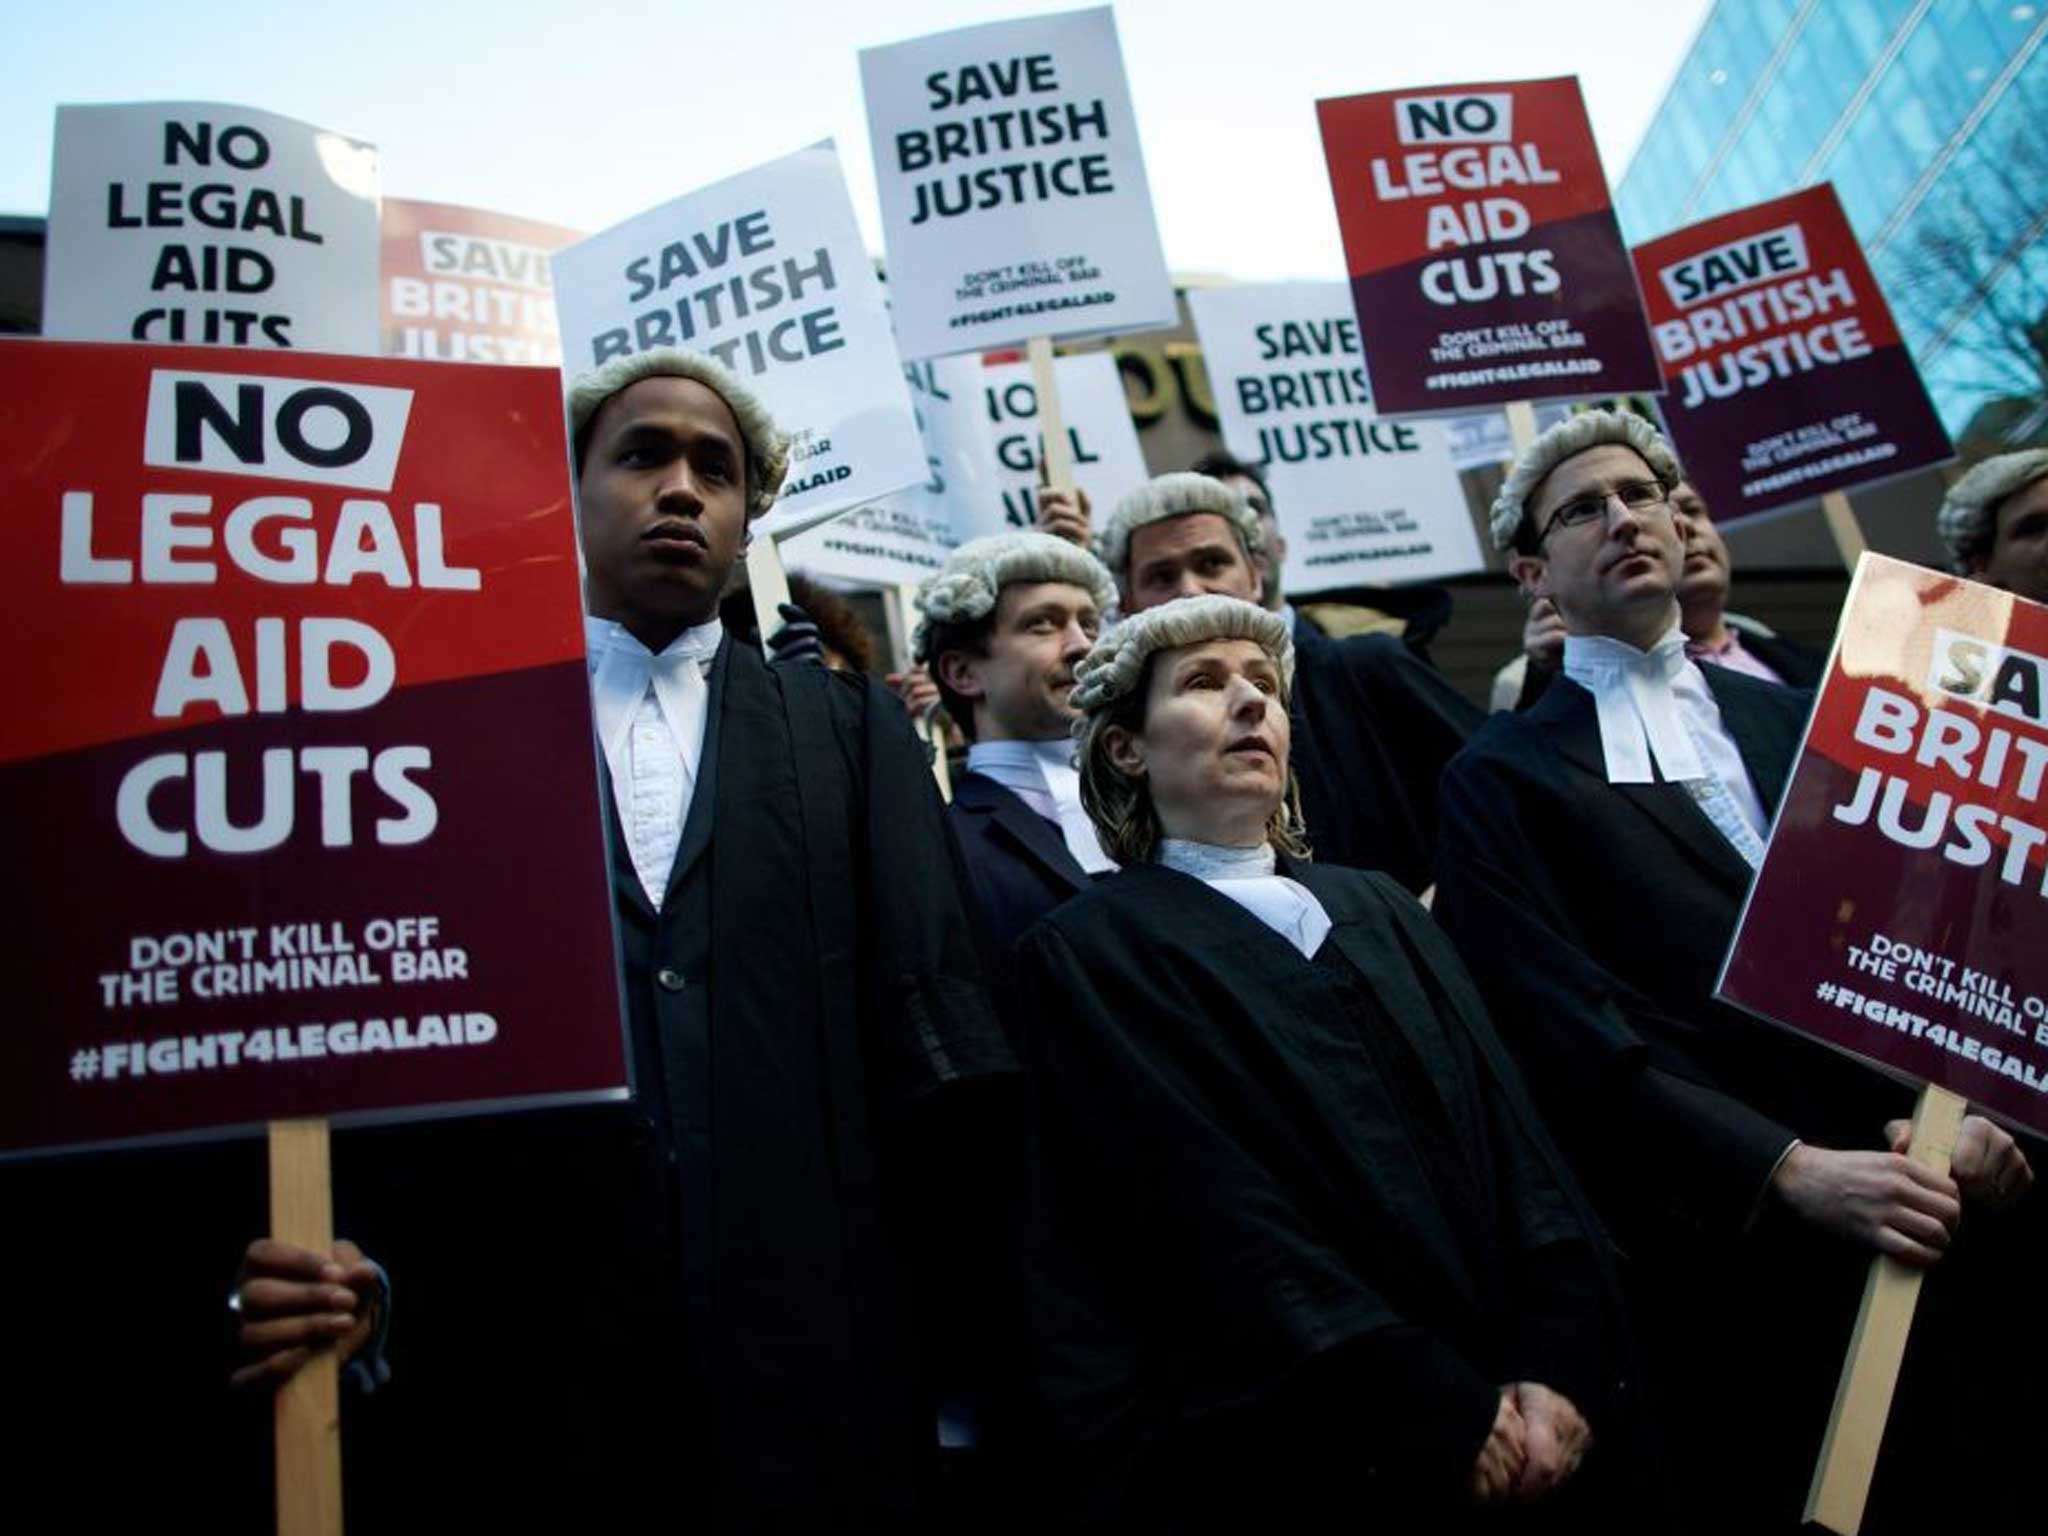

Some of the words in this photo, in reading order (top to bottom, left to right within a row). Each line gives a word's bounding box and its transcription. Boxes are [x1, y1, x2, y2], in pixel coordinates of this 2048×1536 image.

[925, 54, 1059, 111] SAVE
[164, 121, 270, 171] NO
[896, 99, 1109, 173] BRITISH
[1407, 98, 1498, 140] NO
[910, 154, 1115, 226] JUSTICE
[1371, 143, 1561, 201] LEGAL
[107, 182, 324, 245] LEGAL
[1427, 197, 1531, 250] AID
[151, 244, 275, 294] AID
[625, 210, 775, 302] SAVE
[1420, 249, 1562, 305] CUTS
[1673, 236, 1797, 302] SAVE
[708, 306, 846, 376] TICE
[1255, 318, 1358, 361] SAVE
[1653, 268, 1857, 363] BRITISH
[1236, 367, 1370, 415] BRITIS
[1681, 316, 1874, 410] JUSTICE
[175, 381, 373, 468] NO
[1258, 421, 1420, 468] JUSTICE
[60, 491, 481, 590] LEGAL
[152, 616, 397, 718] AID
[1939, 639, 2041, 720] SA
[1854, 686, 2048, 802] BRIT
[116, 746, 439, 858] CUTS
[1832, 766, 2048, 894] JUST
[99, 969, 179, 1008] THE
[191, 953, 381, 999] CRIMINAL
[391, 948, 469, 983] BAR
[130, 926, 258, 971] DON'T
[270, 921, 355, 959] KILL
[364, 915, 440, 951] OFF
[1870, 933, 1956, 980] DON'T
[1960, 967, 2016, 1008] KILL
[1847, 945, 1898, 982] THE
[1904, 970, 2027, 1037] CRIMINAL
[69, 1012, 498, 1081] #FIGHT4LEGALAID
[1816, 980, 2048, 1094] #FIGHT4LEGAL
